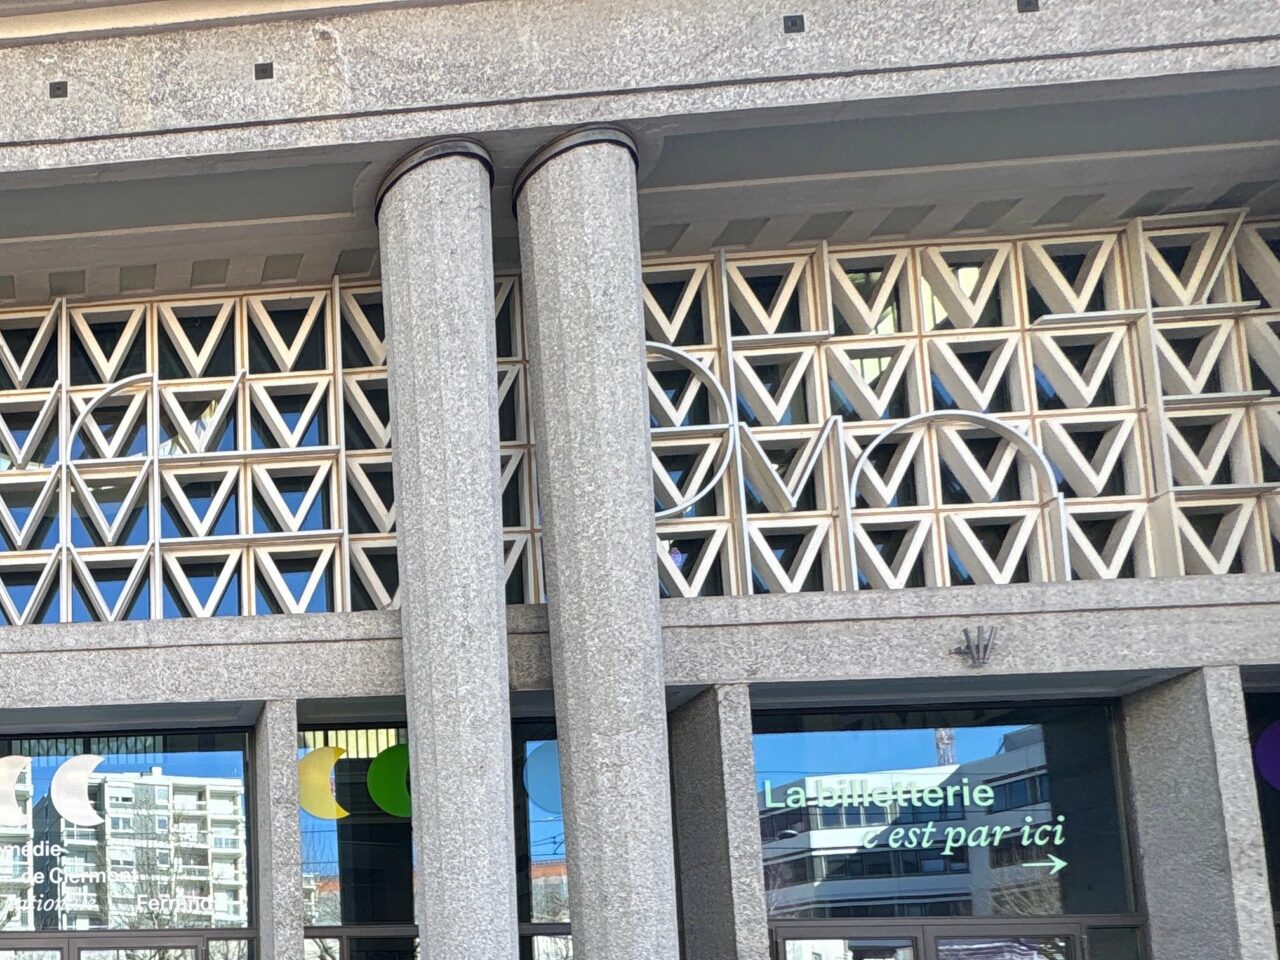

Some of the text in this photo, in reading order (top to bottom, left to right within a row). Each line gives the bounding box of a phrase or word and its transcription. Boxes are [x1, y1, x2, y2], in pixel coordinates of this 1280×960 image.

[764, 778, 995, 808] La billetterie
[941, 825, 1011, 855] par
[1021, 815, 1066, 846] ici
